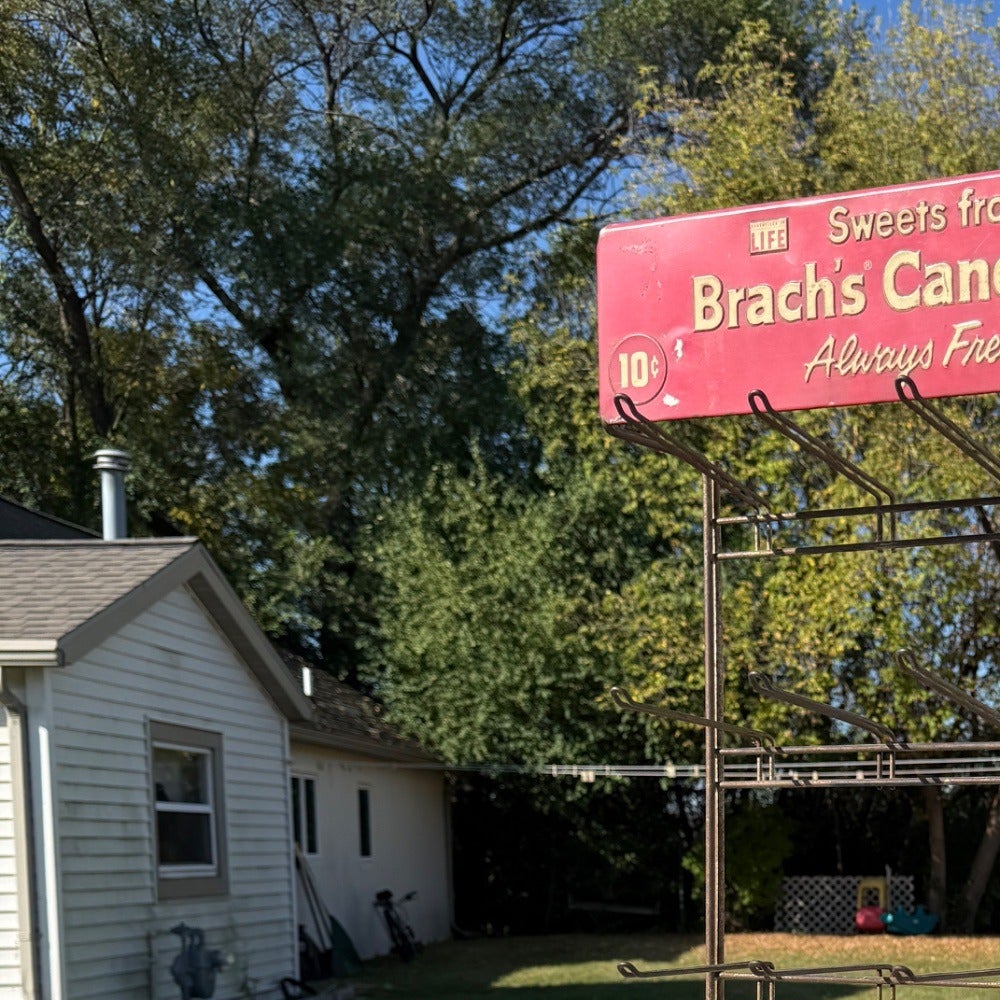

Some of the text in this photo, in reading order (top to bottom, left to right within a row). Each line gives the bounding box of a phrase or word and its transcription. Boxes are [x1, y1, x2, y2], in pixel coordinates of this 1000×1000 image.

[751, 229, 786, 251] LIFE
[828, 206, 948, 244] Sweets
[803, 334, 935, 386] Always
